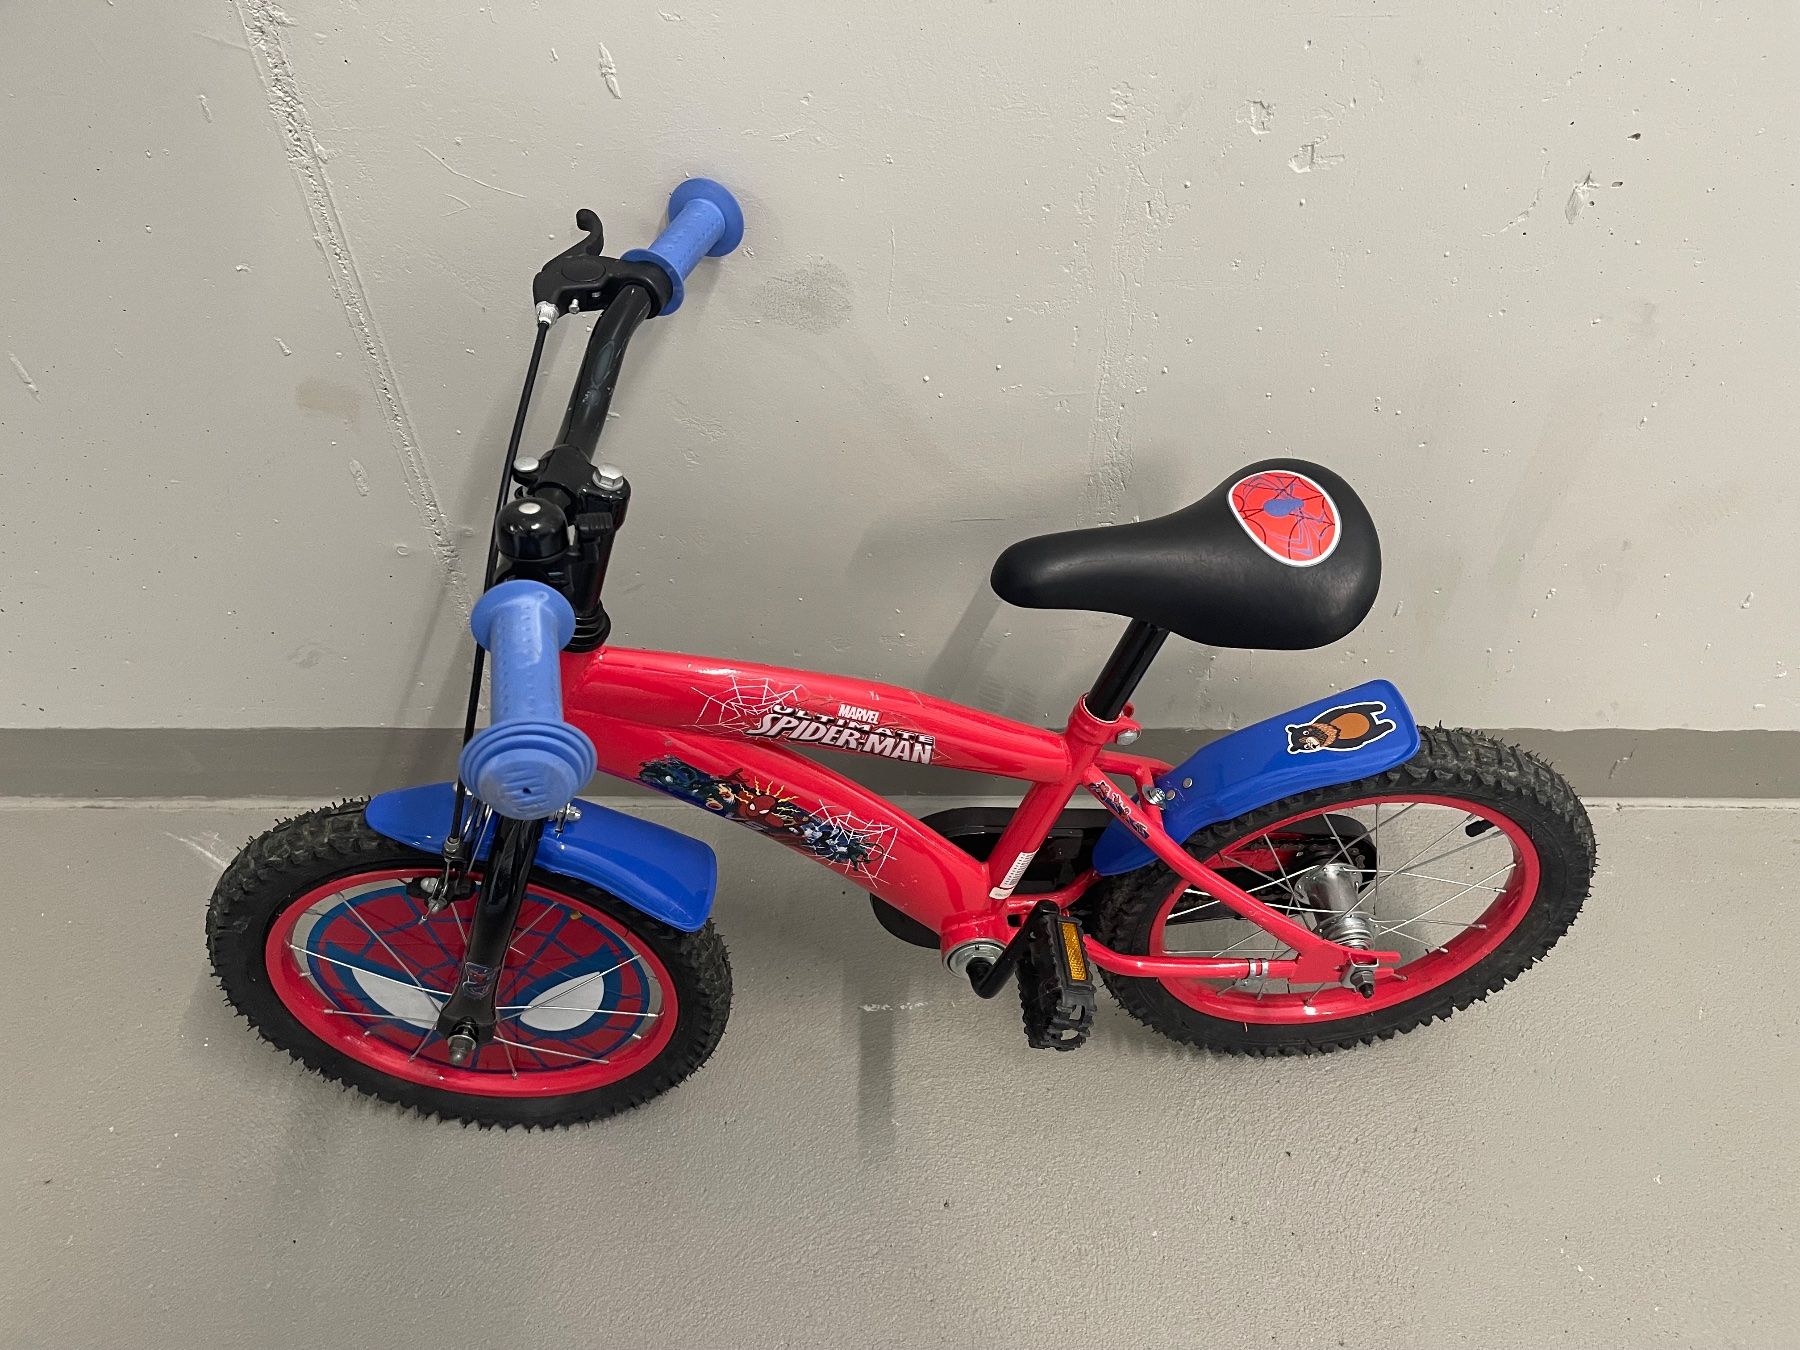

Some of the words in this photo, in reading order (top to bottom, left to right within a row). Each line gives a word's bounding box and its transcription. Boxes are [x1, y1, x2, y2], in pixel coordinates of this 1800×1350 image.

[773, 703, 934, 743] ULTIMATE
[839, 703, 879, 724] MARVEL
[746, 713, 933, 764] SPIDER-MAN
